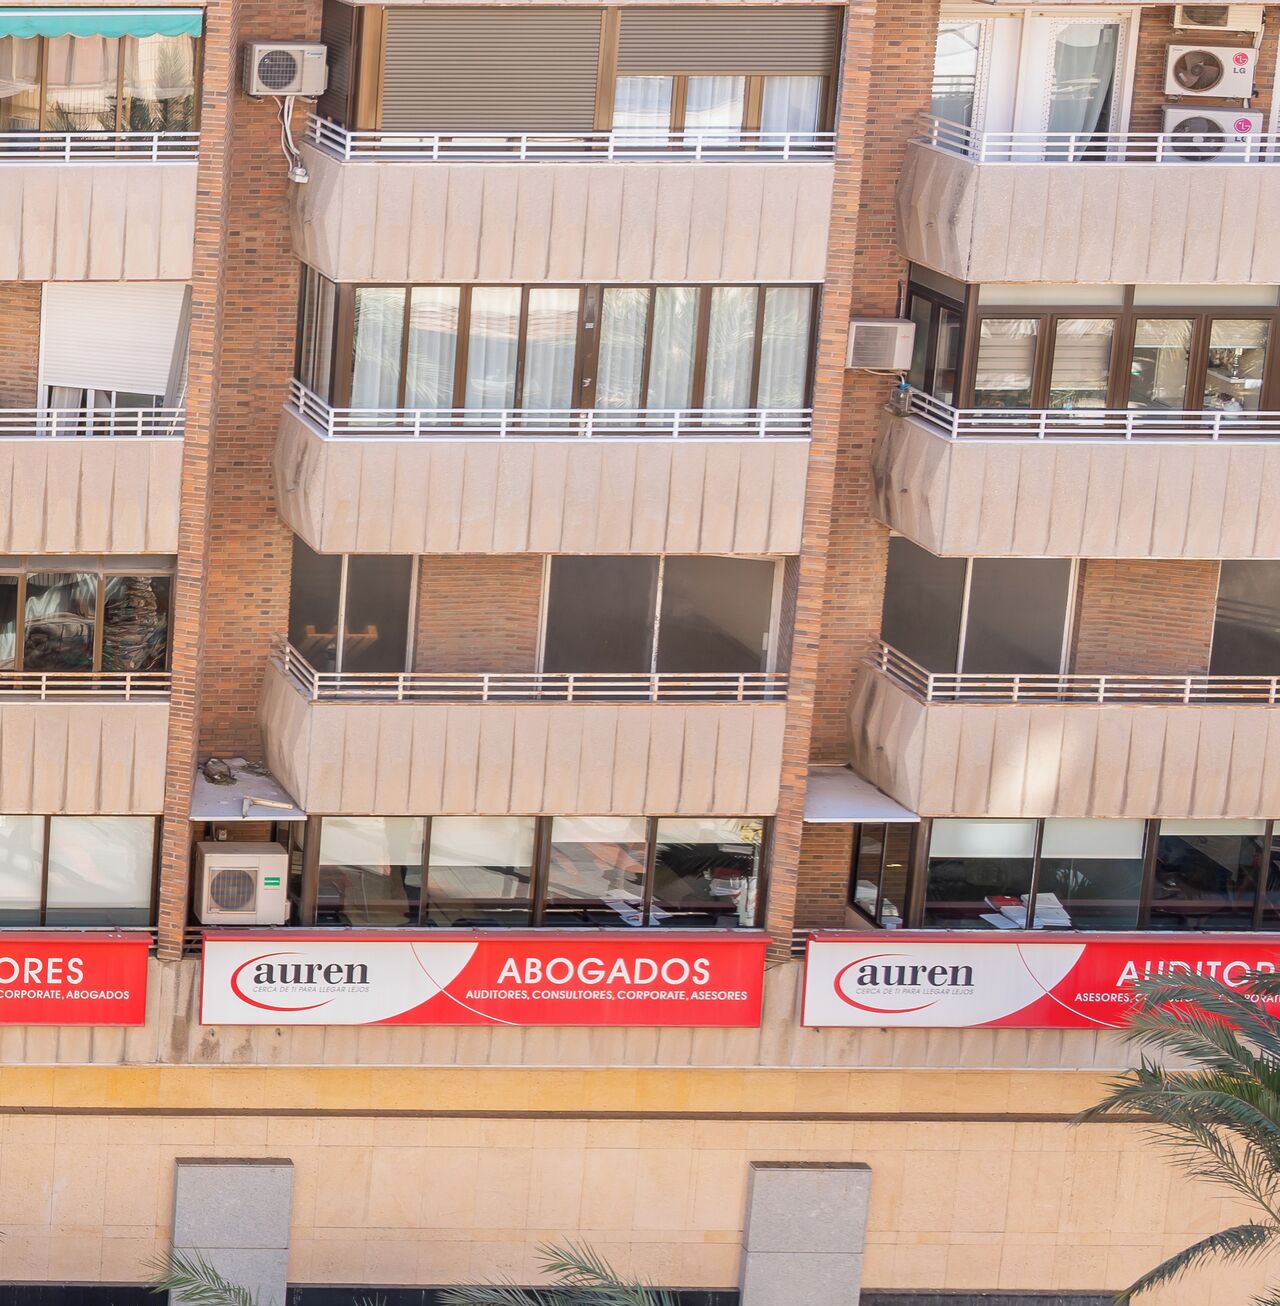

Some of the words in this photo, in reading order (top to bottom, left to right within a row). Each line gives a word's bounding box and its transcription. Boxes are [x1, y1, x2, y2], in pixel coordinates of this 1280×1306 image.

[253, 957, 370, 985] auren
[497, 957, 711, 985] ABOGADOS
[856, 962, 974, 987] auren
[66, 990, 130, 1001] ABOGADOS
[466, 990, 530, 1000] AUDITORES,
[532, 990, 615, 1001] CONSULTORES,
[617, 990, 689, 1001] CORPORATE,
[690, 990, 748, 1001] ASESORES
